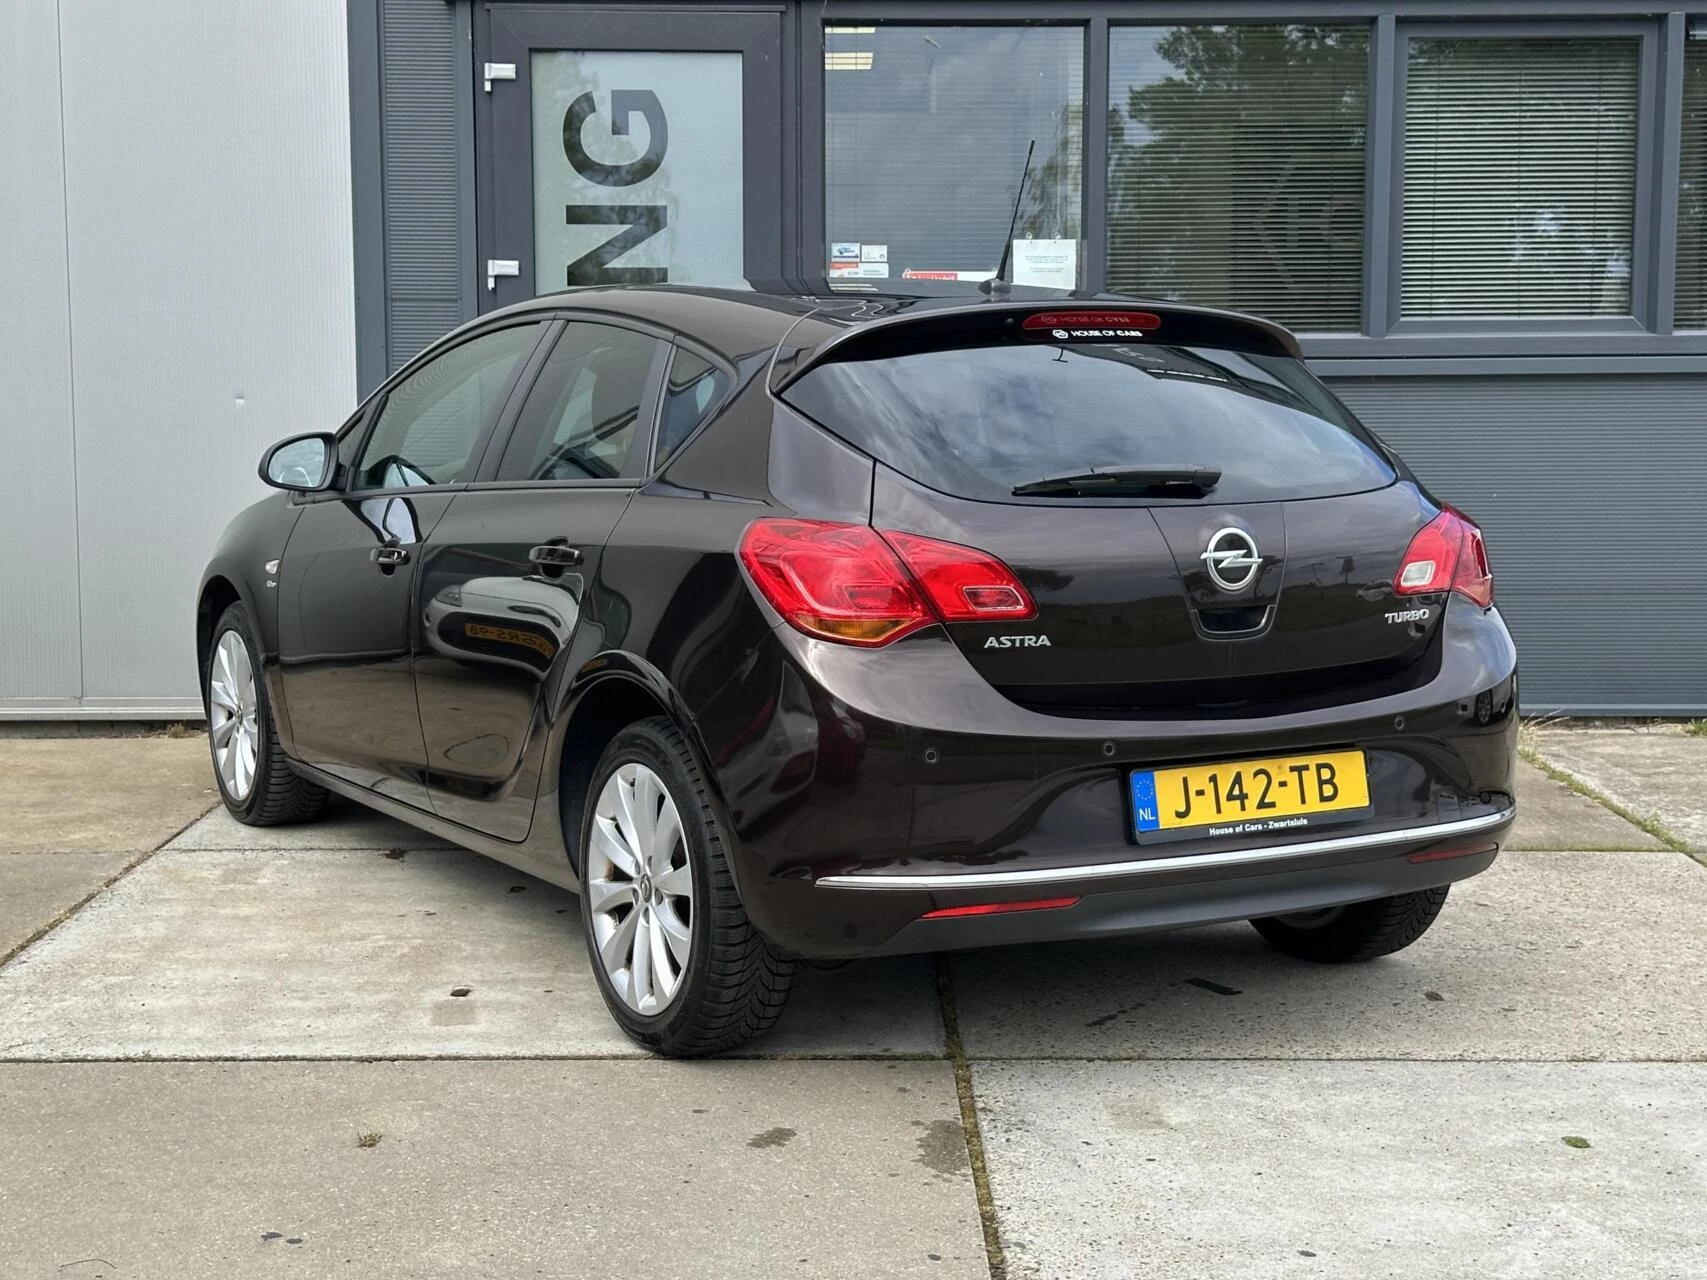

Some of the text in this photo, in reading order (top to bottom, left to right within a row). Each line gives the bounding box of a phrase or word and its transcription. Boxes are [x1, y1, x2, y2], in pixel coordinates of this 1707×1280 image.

[1116, 329, 1143, 337] CARS
[1384, 608, 1430, 624] TURBO
[983, 634, 1052, 649] ASTRA
[1139, 762, 1339, 821] NL J-142-TB
[1209, 827, 1234, 836] House
[1235, 824, 1243, 833] of
[1244, 823, 1263, 832] Cars
[1268, 817, 1308, 829] Zwartsluis
